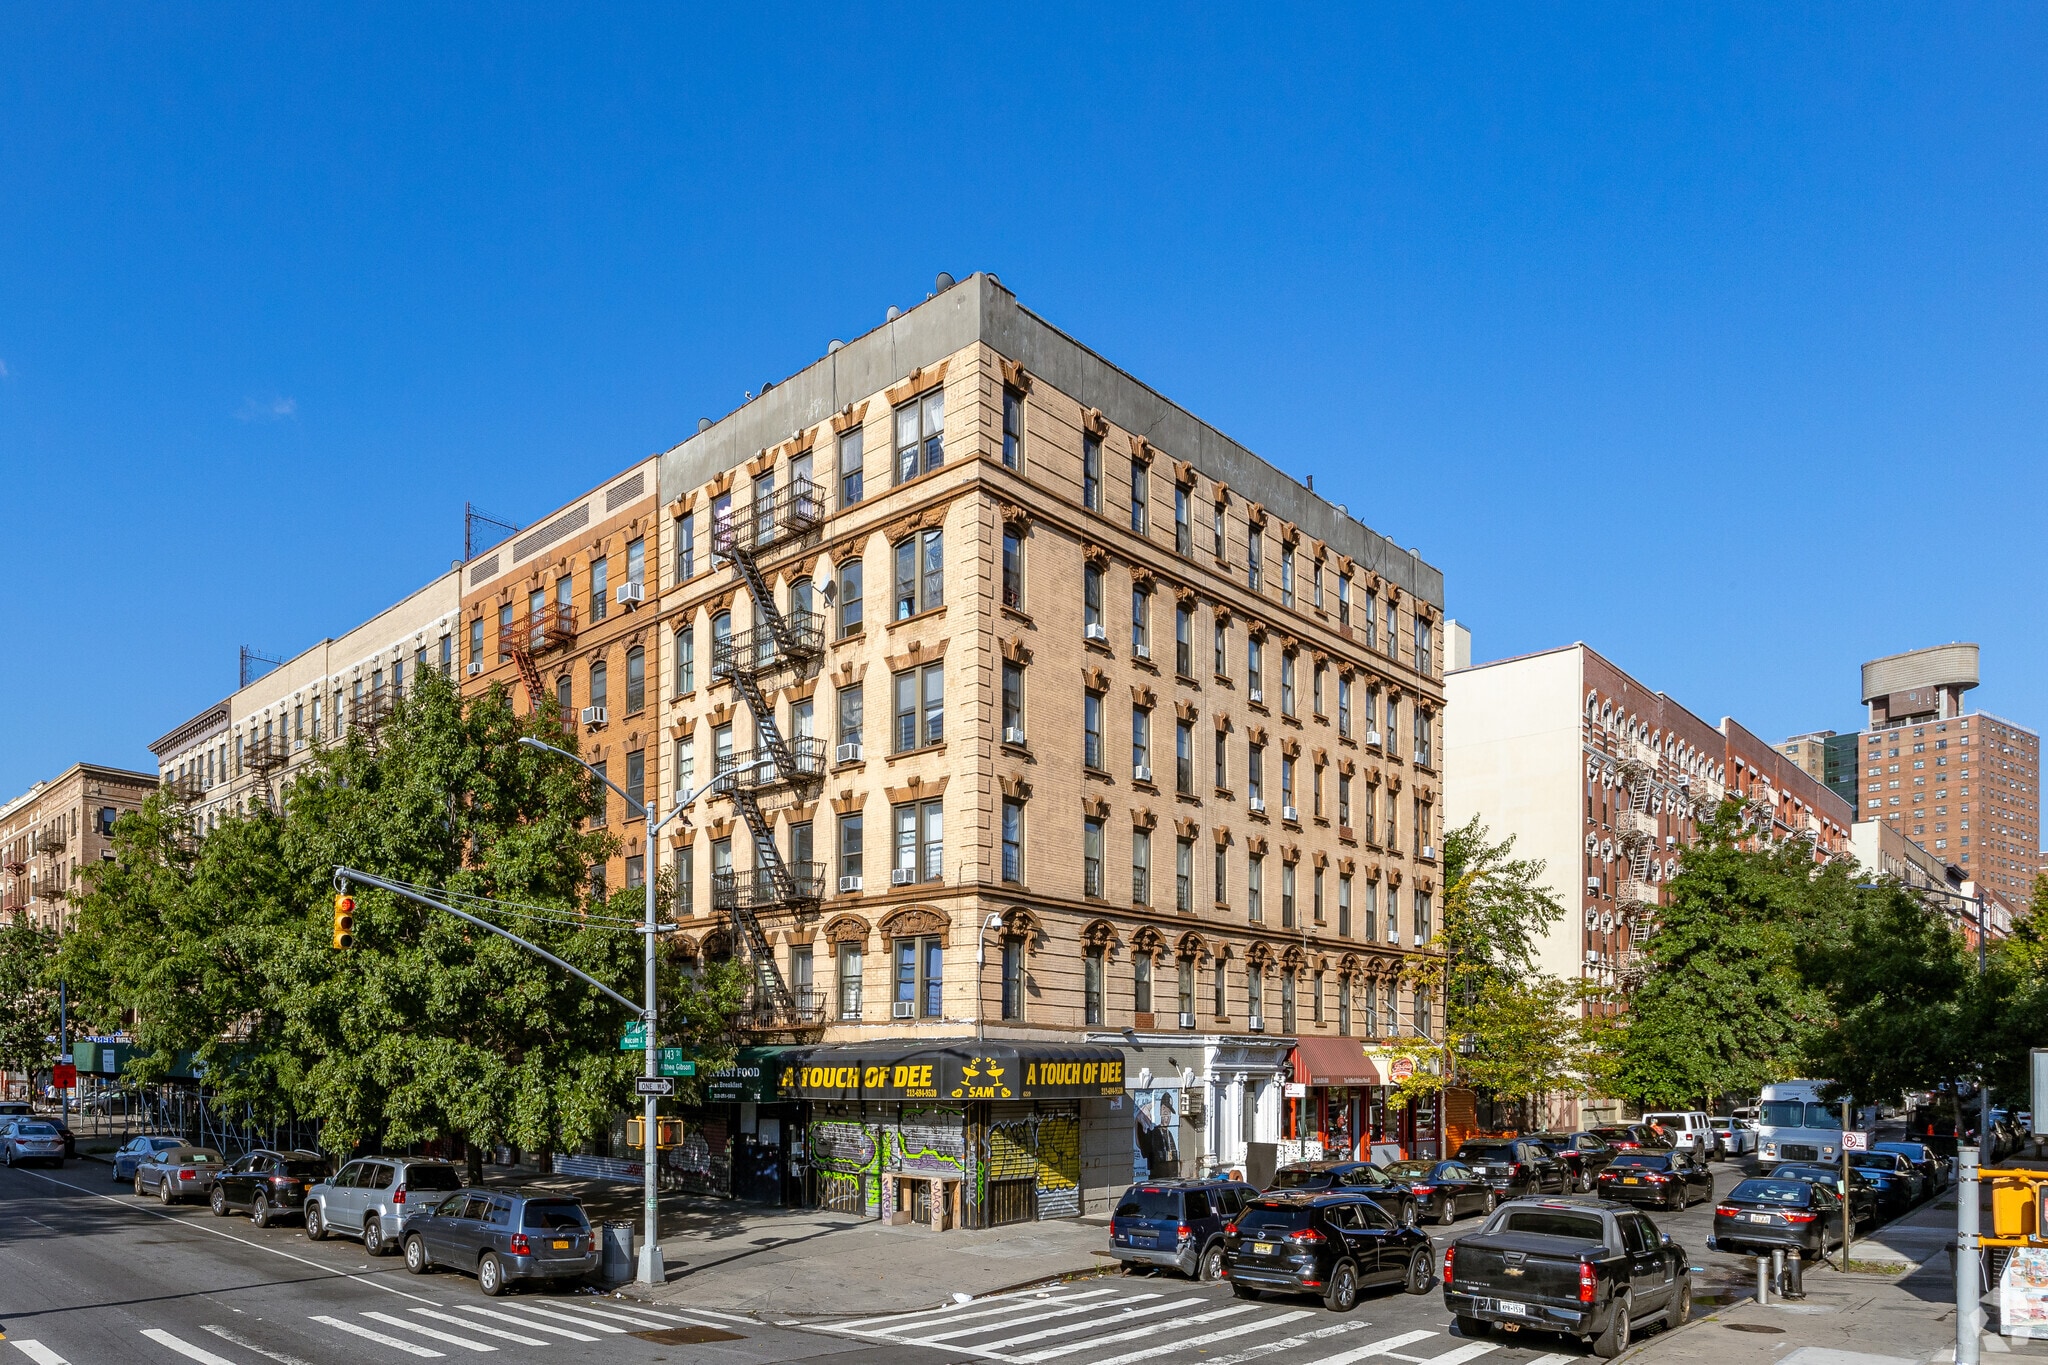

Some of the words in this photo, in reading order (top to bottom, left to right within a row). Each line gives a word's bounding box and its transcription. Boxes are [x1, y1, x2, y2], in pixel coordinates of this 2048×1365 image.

[664, 1050, 674, 1060] 143
[676, 1063, 691, 1071] Gibson
[737, 1067, 760, 1077] FOOD
[781, 1067, 795, 1086] A
[800, 1067, 860, 1087] TOUCH
[864, 1066, 890, 1087] OF
[893, 1065, 933, 1087] DEE
[1026, 1063, 1036, 1085] A
[1041, 1063, 1080, 1084] TOUCH
[1083, 1062, 1098, 1084] OF
[1100, 1062, 1122, 1083] DEE
[968, 1087, 995, 1098] SAM
